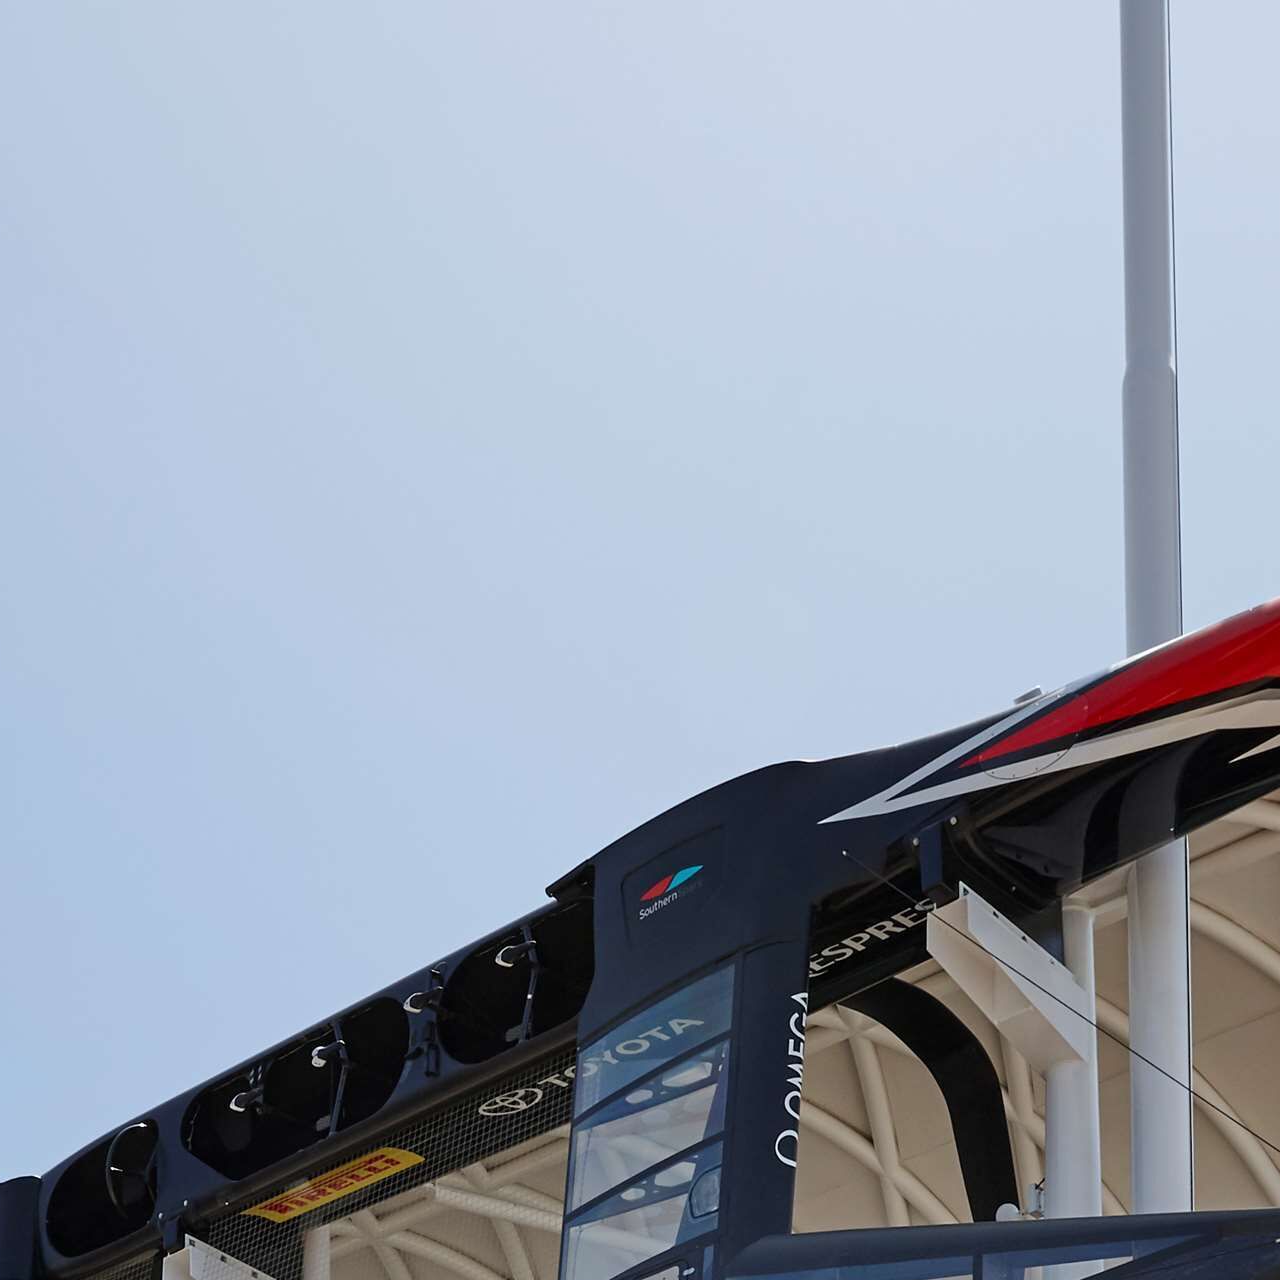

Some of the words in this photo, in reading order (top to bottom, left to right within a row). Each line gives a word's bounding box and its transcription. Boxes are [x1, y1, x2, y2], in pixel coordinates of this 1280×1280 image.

[639, 892, 678, 920] Southern
[809, 898, 937, 977] ESPRES
[538, 1016, 705, 1088] TOYOTA
[259, 1153, 401, 1214] PIRELLI
